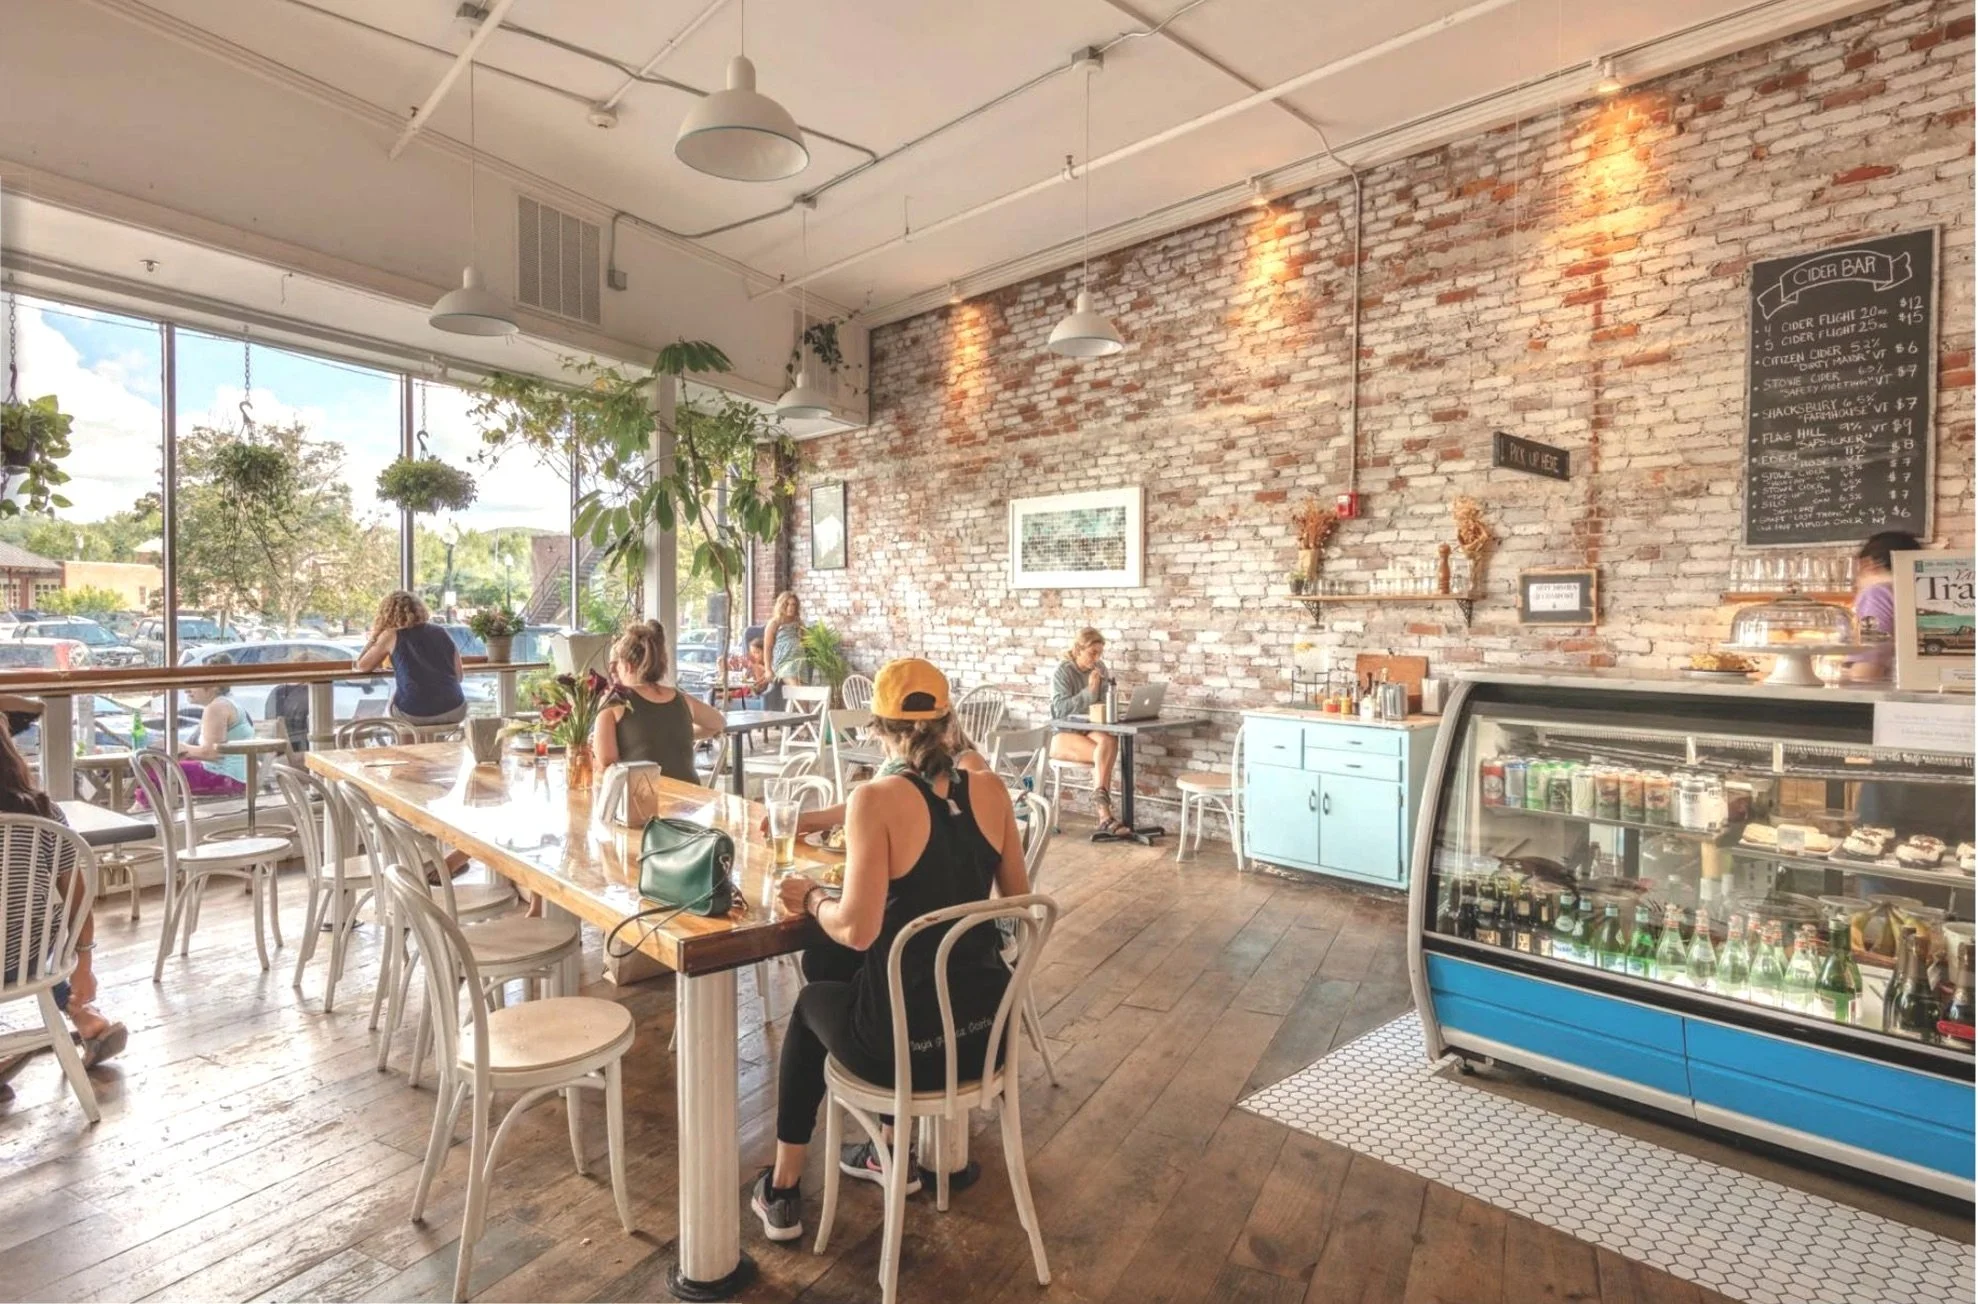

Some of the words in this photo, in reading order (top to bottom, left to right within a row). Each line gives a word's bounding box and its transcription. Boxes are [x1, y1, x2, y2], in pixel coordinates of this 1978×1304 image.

[1792, 264, 1837, 285] CIDER
[1841, 256, 1876, 277] BAR
[1781, 317, 1814, 333] CIDER
[1819, 309, 1856, 325] FLIGHT
[1900, 296, 1924, 310] $12
[1781, 332, 1814, 346] CIDER
[1819, 323, 1856, 339] FLIGHT
[1898, 310, 1923, 325] $15
[1762, 350, 1805, 367] CITIZEN
[1810, 345, 1842, 360] CIDER
[1873, 349, 1887, 359] VT
[1810, 371, 1841, 384] CIDER
[1874, 373, 1893, 386] VT
[1873, 401, 1888, 413] VT
[1762, 431, 1792, 445] FLAG
[1797, 427, 1827, 440] HILL
